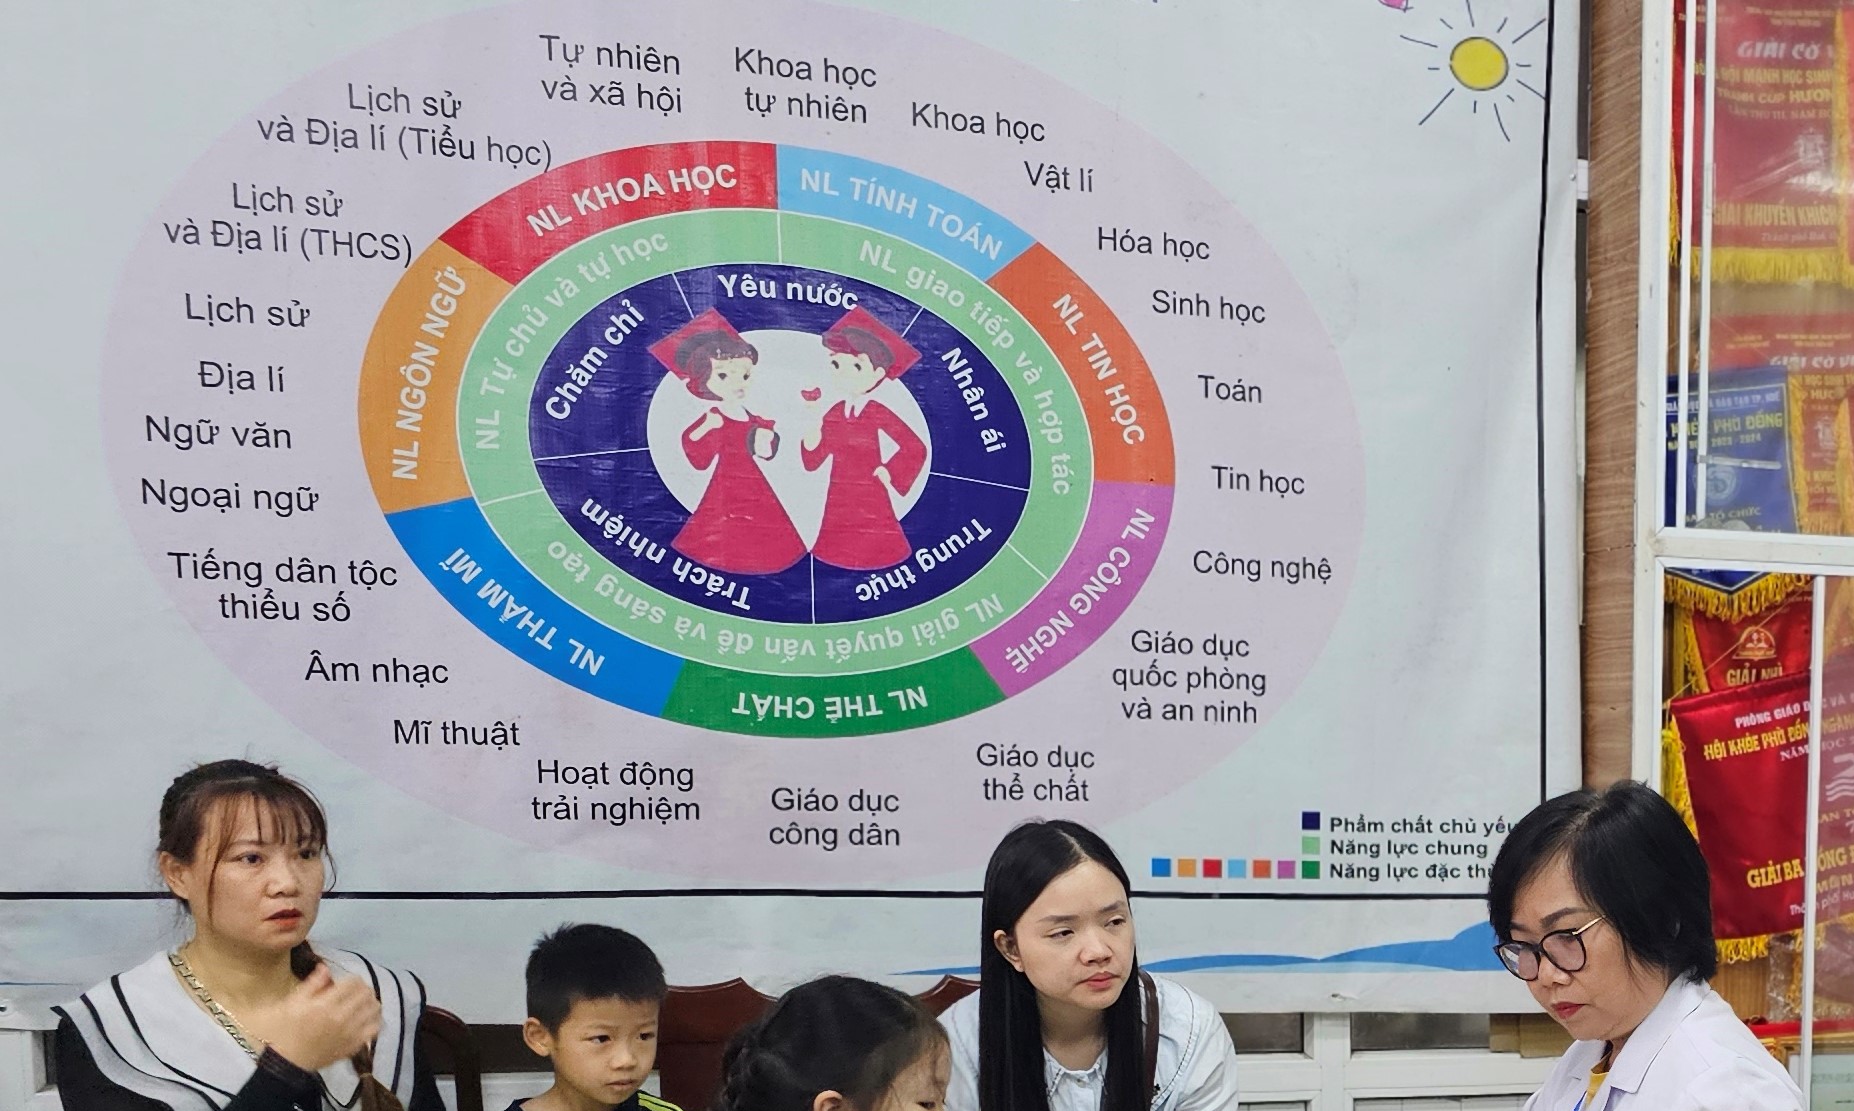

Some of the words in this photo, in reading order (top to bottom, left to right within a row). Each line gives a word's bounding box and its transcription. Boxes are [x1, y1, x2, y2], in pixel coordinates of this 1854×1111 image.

[539, 35, 584, 63] Tự
[597, 43, 679, 75] nhiên
[736, 47, 812, 80] Khoa
[824, 58, 876, 90] học
[348, 83, 410, 116] Lịch
[423, 91, 461, 119] sử
[541, 75, 577, 101] và
[590, 81, 624, 106] xã
[638, 83, 681, 116] hội
[745, 87, 776, 117] tự
[788, 93, 866, 123] nhiên
[258, 115, 294, 143] và
[305, 118, 358, 153] Địa
[371, 124, 385, 150] lí
[399, 124, 474, 160] (Tiểu
[487, 135, 553, 172] học)
[526, 206, 573, 236] NL
[572, 175, 665, 216] KHOA
[667, 164, 737, 196] HỌC
[800, 168, 839, 196] NL
[850, 177, 918, 219] TÍNH
[927, 204, 1003, 261] TOÁN
[1099, 227, 1152, 254] Hóa
[1164, 232, 1209, 262] học
[717, 274, 776, 298] Yêu
[789, 281, 860, 309] nước
[1153, 290, 1209, 317] Sinh
[1221, 296, 1265, 326] học
[545, 346, 608, 420] Chăm
[604, 299, 646, 346] chỉ
[1198, 375, 1261, 403] Toán
[146, 415, 219, 450] Ngữ
[232, 422, 291, 448] văn
[167, 548, 262, 588] Tiếng
[276, 557, 336, 584] dân
[348, 560, 397, 590] tộc
[1194, 551, 1260, 582] Công
[1272, 557, 1331, 584] nghệ
[219, 588, 299, 620] thiểu
[313, 591, 350, 621] số
[1132, 630, 1193, 654] Giáo
[1203, 634, 1249, 661] dục
[1113, 659, 1177, 691] quốc
[1187, 666, 1265, 696] phòng
[1726, 663, 1758, 686] GIẢI
[1122, 697, 1151, 719] và
[1162, 704, 1193, 721] an
[1205, 700, 1256, 723] ninh
[1734, 710, 1772, 730] PHÒNG
[1773, 701, 1801, 722] GIÁO
[1703, 741, 1728, 762] HỘI
[1762, 726, 1787, 749] PHÙ
[538, 760, 609, 789] Hoạt
[620, 762, 693, 792] động
[532, 795, 578, 820] trải
[591, 797, 699, 826] nghiệm
[1330, 814, 1384, 833] Phẩm
[1391, 815, 1433, 833] chất
[1440, 818, 1476, 833] chủ
[1330, 840, 1380, 858] Năng
[1388, 840, 1419, 858] lực
[1425, 840, 1488, 858] chung
[1330, 864, 1380, 881] Năng
[1387, 864, 1419, 881] lực
[1425, 864, 1461, 882] đặc
[1746, 863, 1783, 889] GIẢI
[1783, 859, 1805, 878] BA
